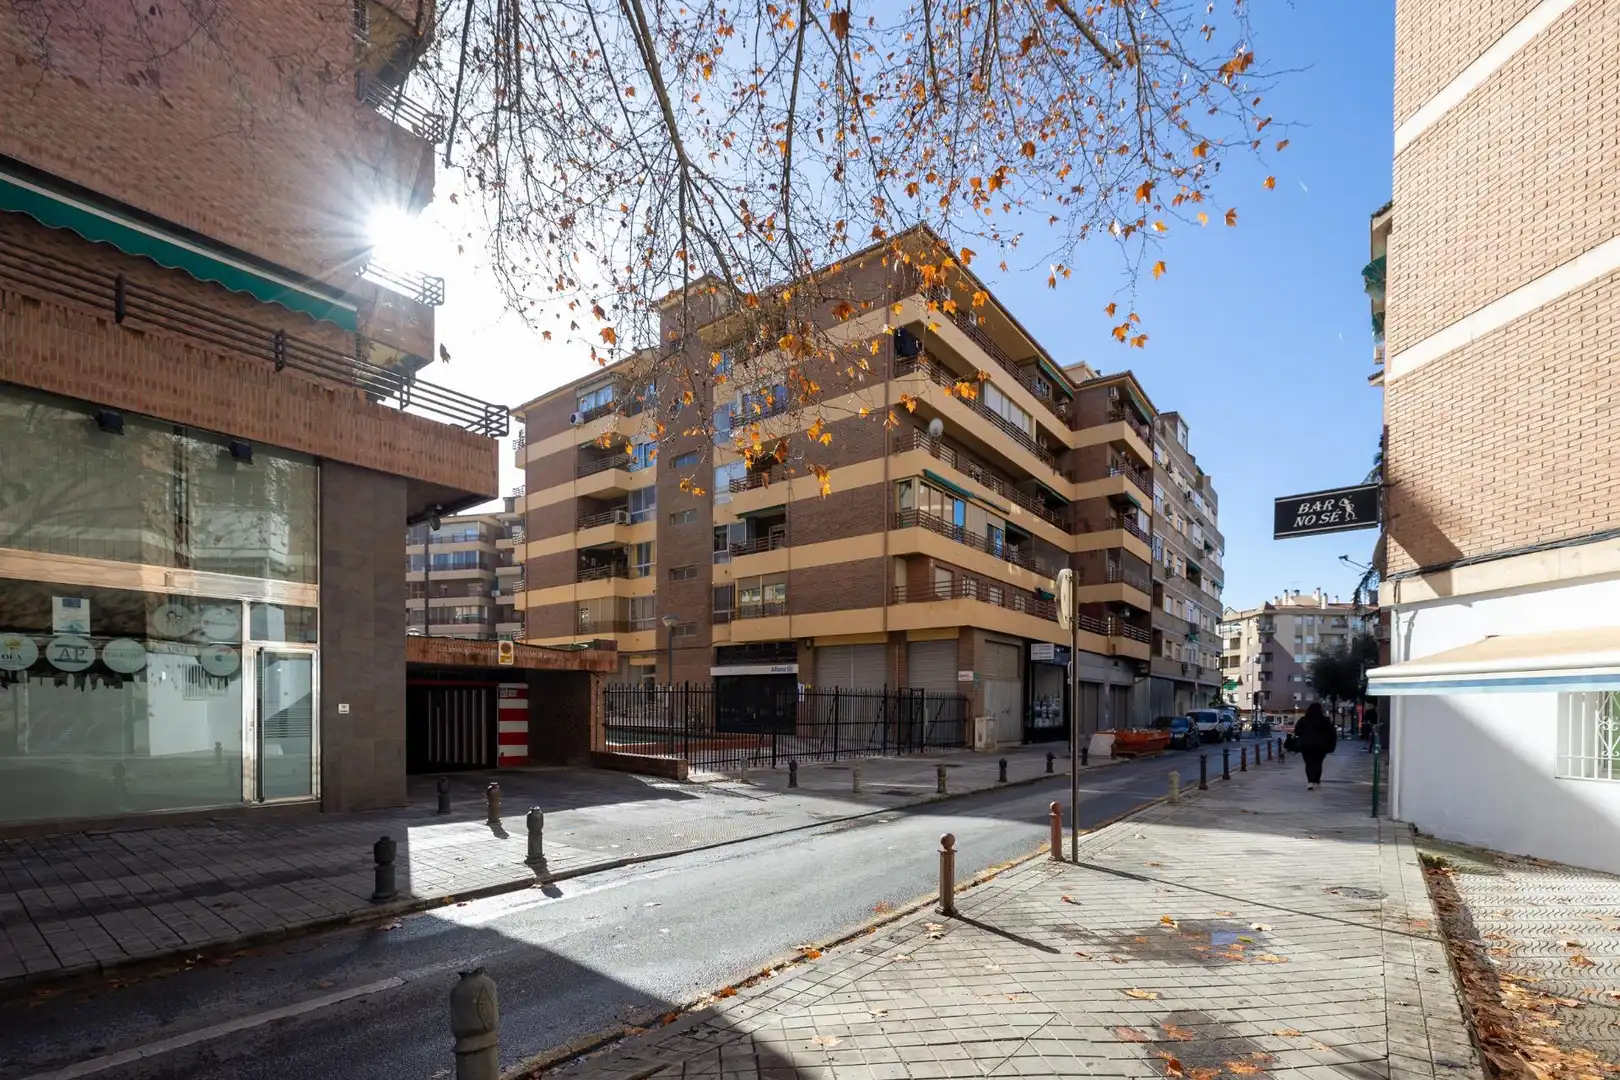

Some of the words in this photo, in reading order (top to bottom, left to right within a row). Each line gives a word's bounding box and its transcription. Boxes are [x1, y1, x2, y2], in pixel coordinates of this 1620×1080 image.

[1297, 498, 1335, 514] BAR
[1293, 514, 1316, 528] NO
[1318, 508, 1342, 524] SÉ
[58, 647, 85, 661] AP
